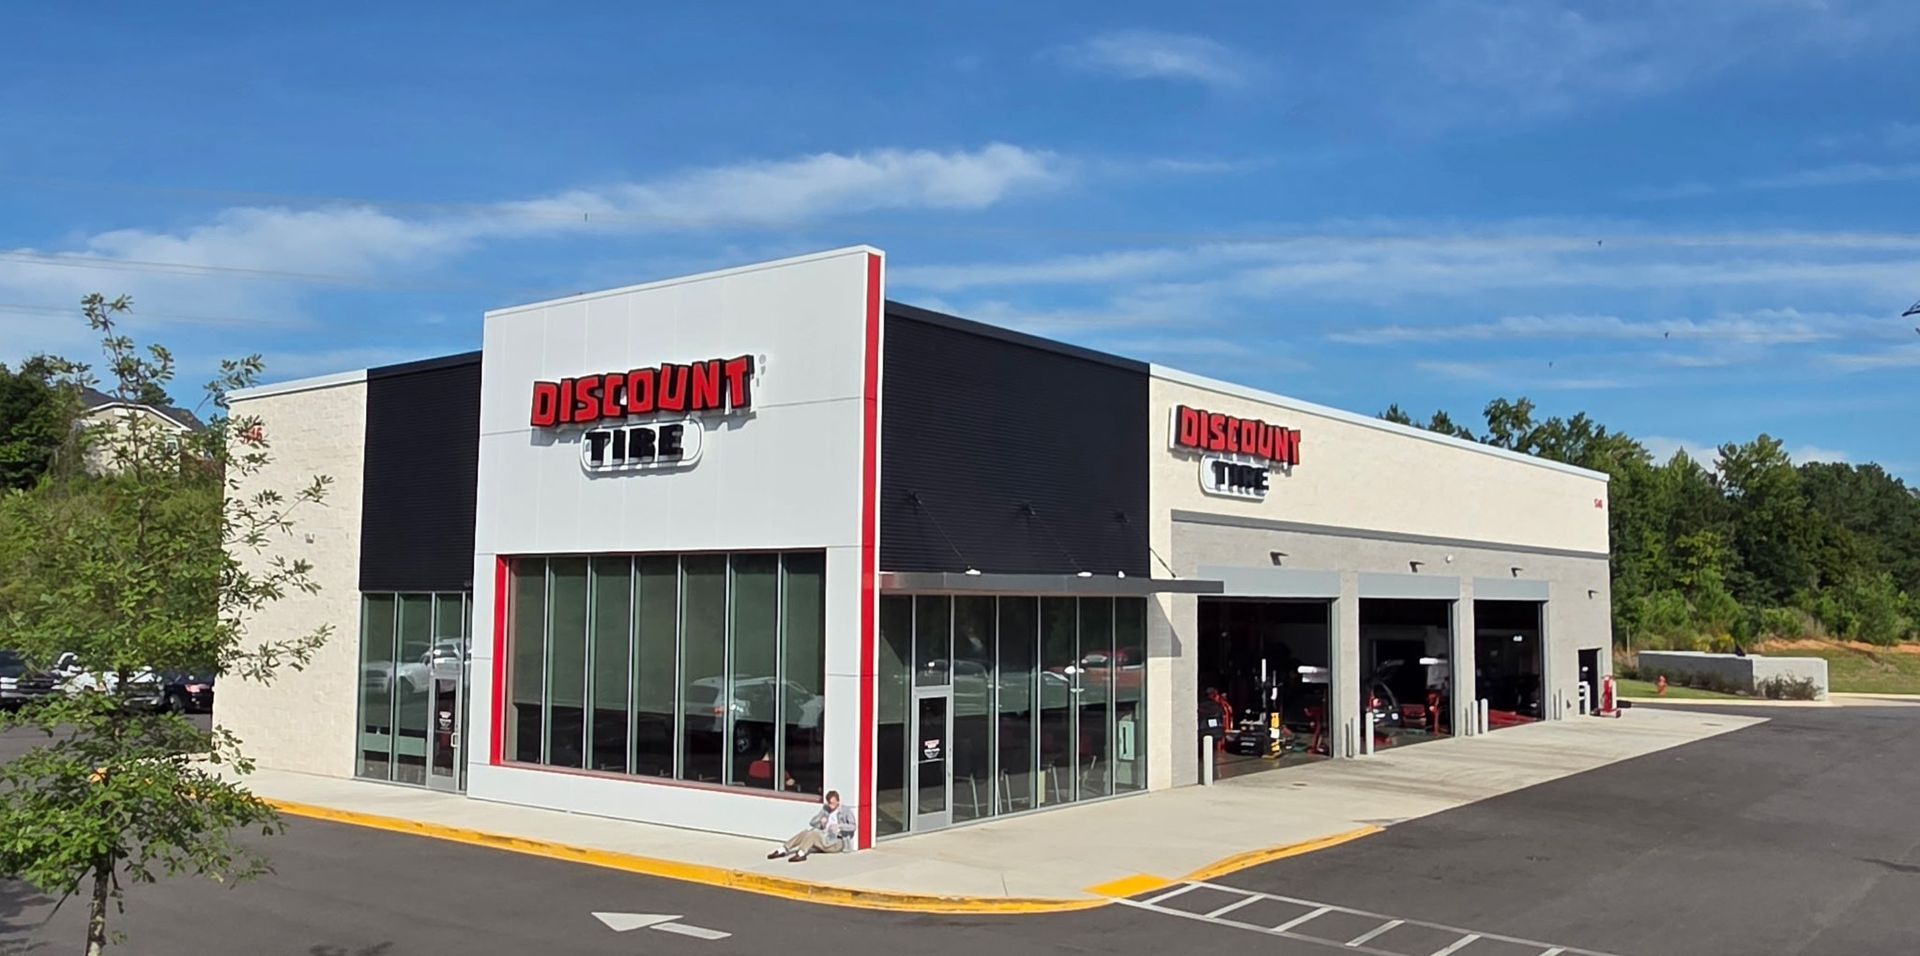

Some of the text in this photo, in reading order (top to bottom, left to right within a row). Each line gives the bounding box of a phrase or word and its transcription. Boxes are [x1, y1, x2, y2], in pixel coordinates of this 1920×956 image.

[530, 354, 754, 427] DISCOUNT
[586, 424, 683, 462] TIRE
[1174, 404, 1301, 465] DISCOUNT
[1212, 460, 1269, 491] TIRE
